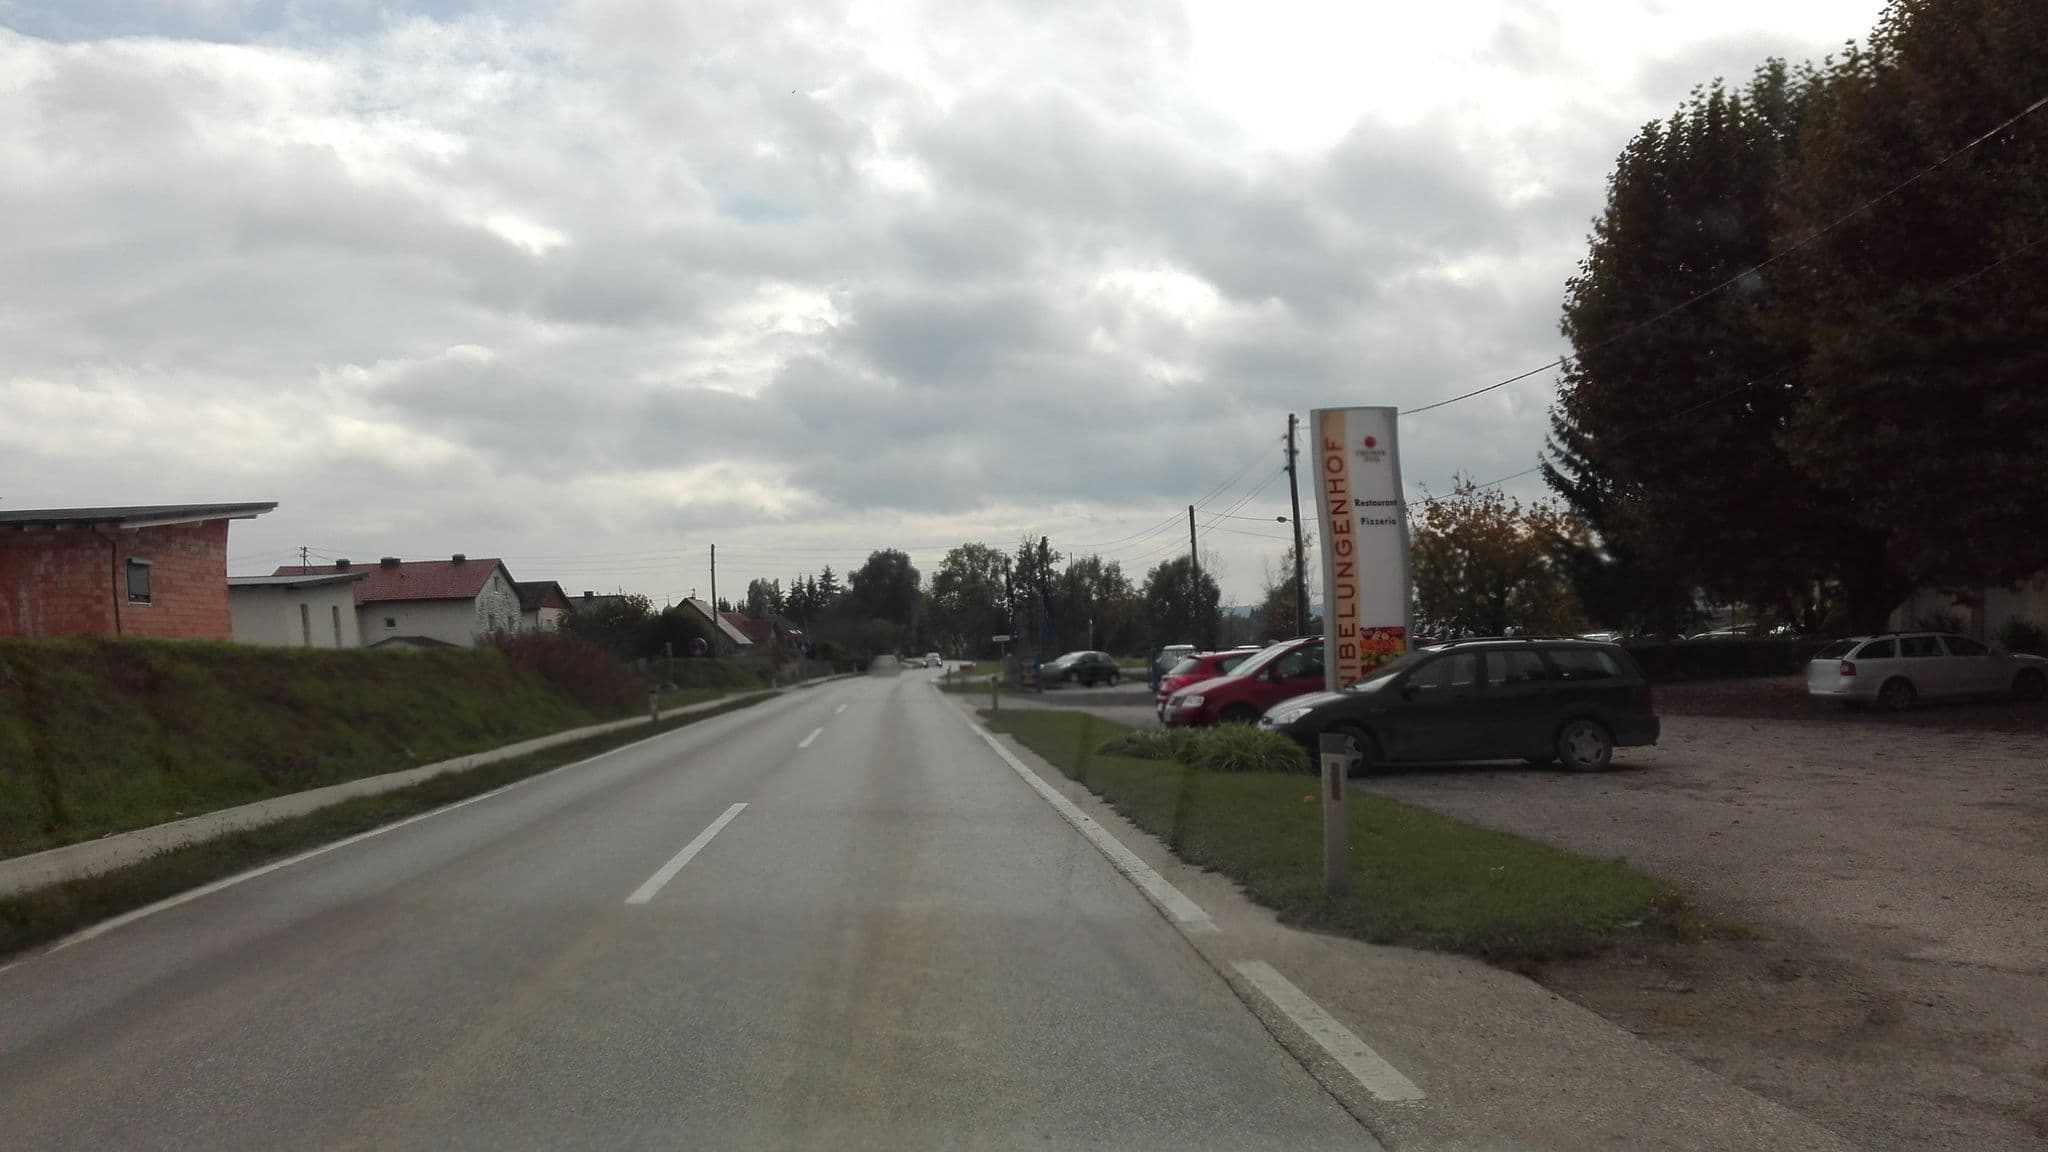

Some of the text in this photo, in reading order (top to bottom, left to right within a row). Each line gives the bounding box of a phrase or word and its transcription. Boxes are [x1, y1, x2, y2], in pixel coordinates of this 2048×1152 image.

[1354, 498, 1397, 507] Restaurant
[1360, 516, 1397, 526] Pizzeria
[1325, 436, 1356, 688] NIBELUNGENHOF
